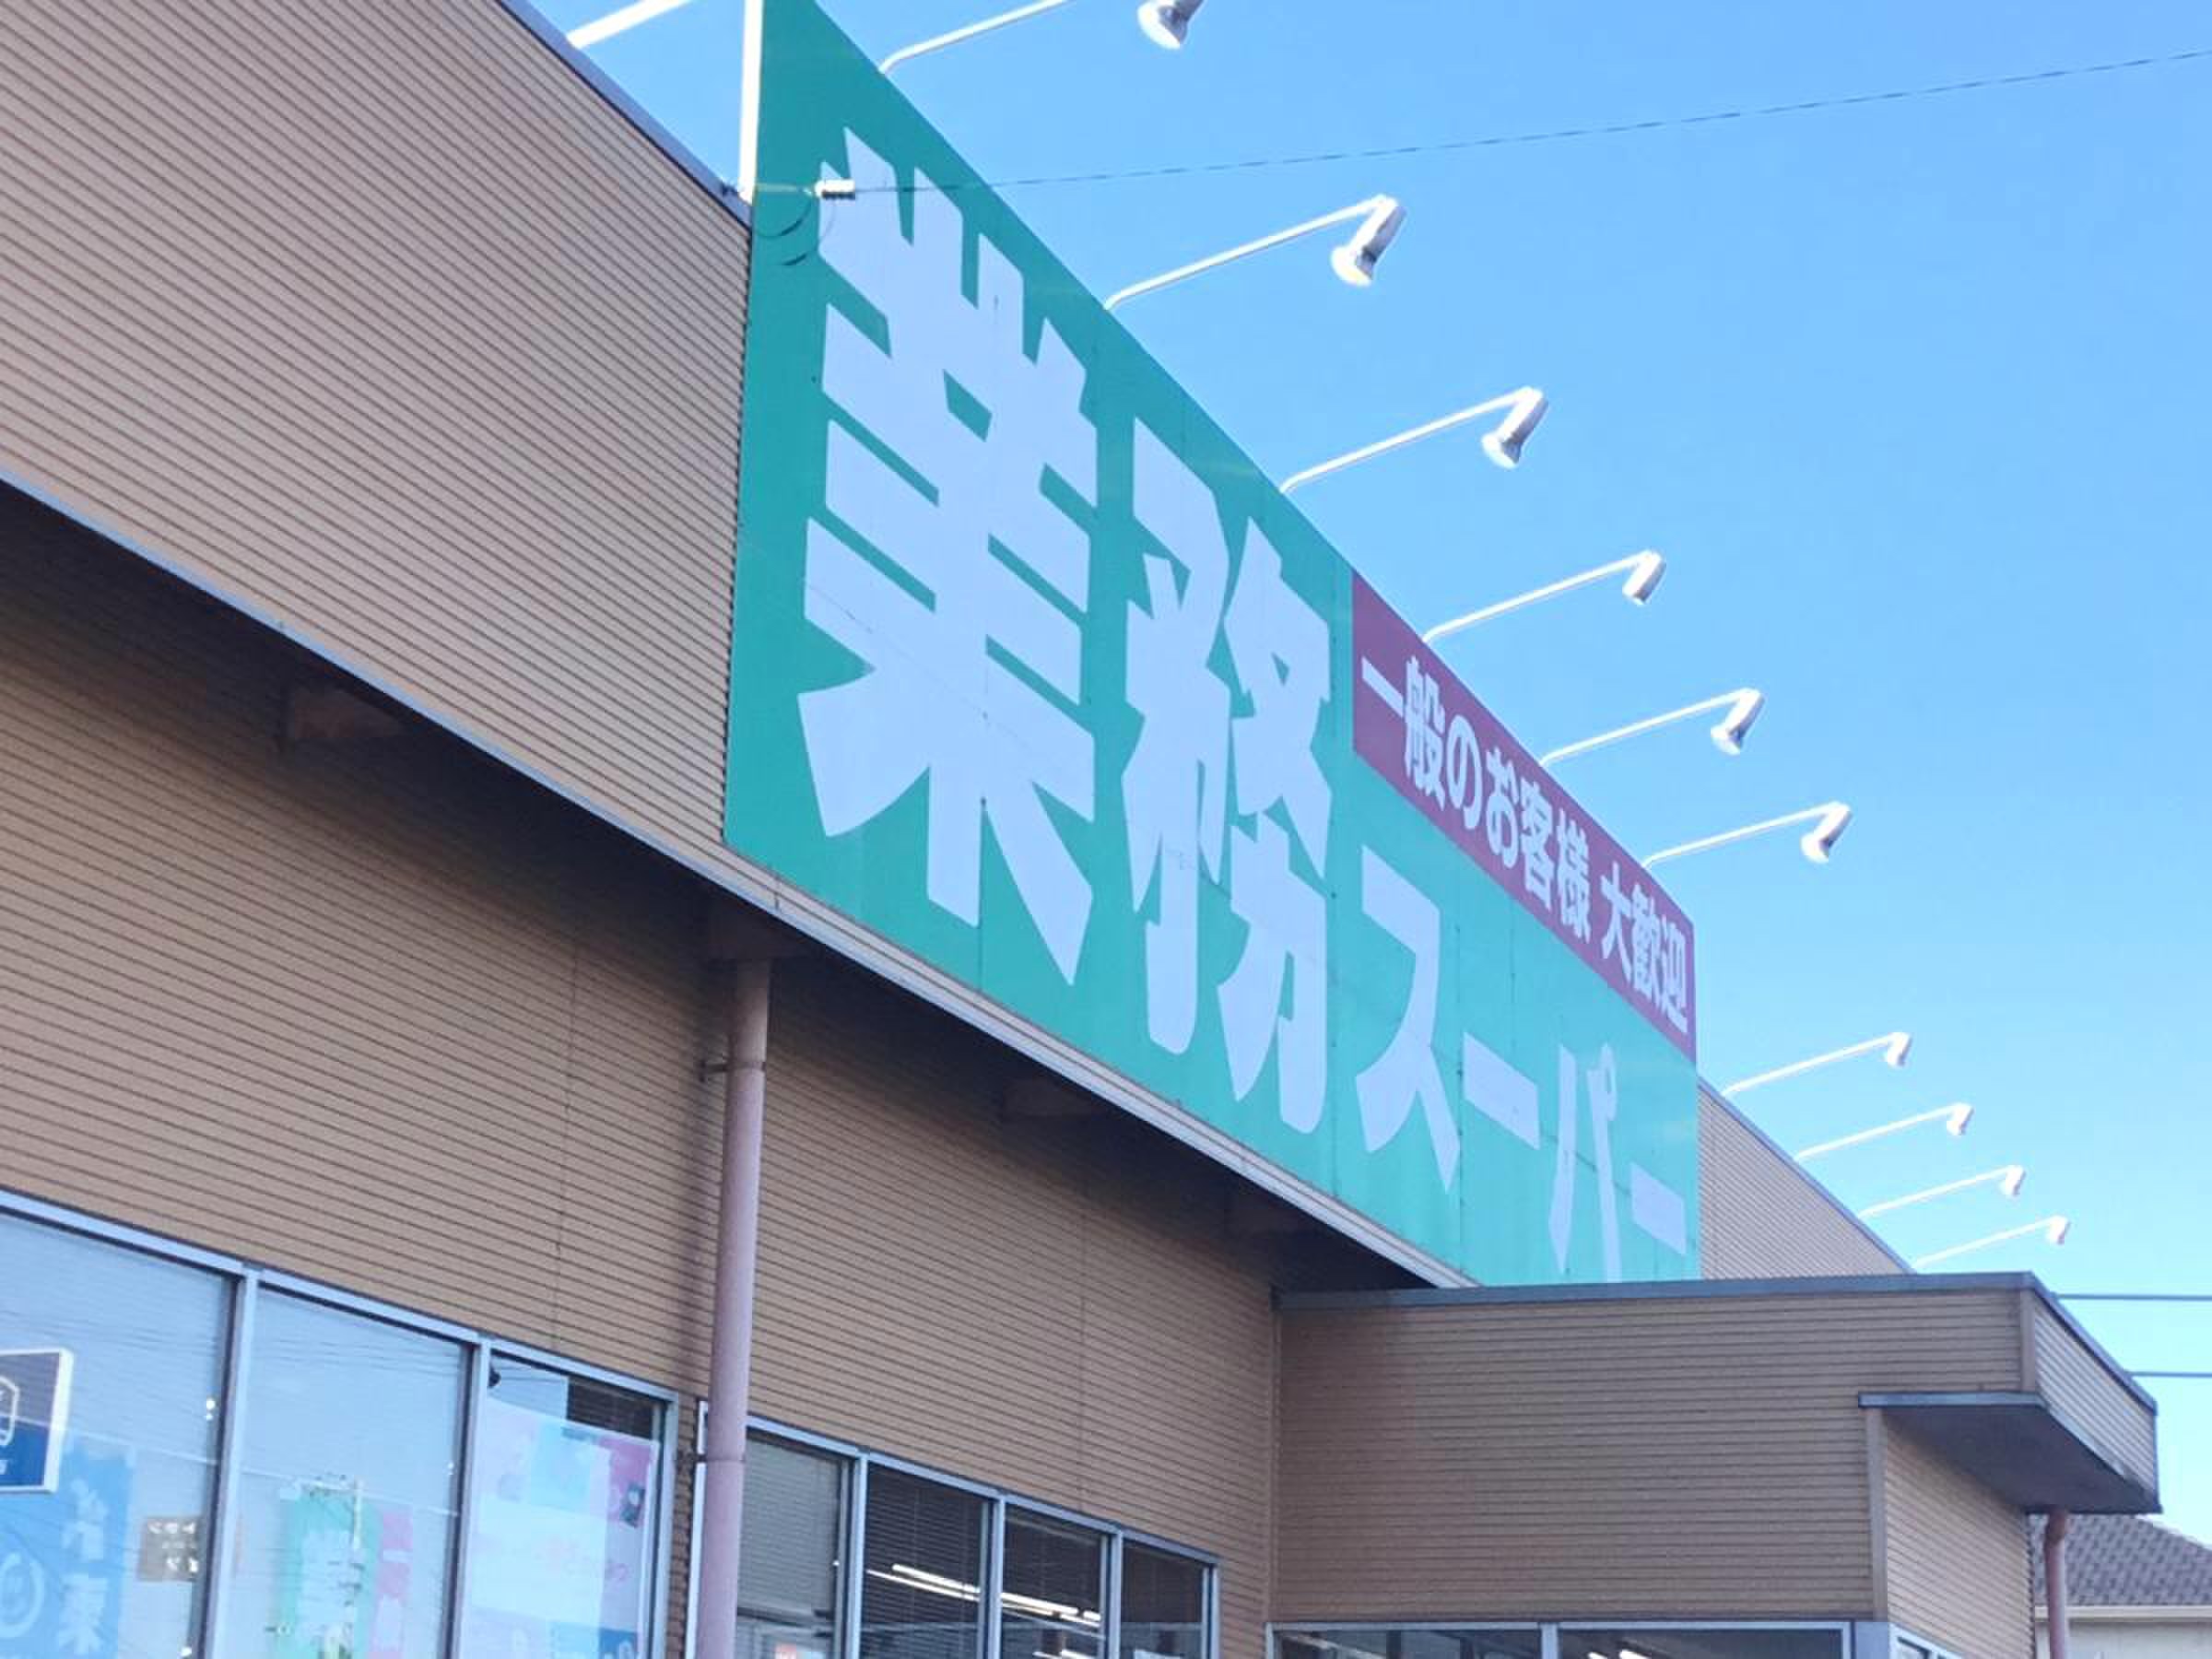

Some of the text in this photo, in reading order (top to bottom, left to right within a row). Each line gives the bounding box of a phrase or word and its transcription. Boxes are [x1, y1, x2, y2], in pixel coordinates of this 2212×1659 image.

[799, 128, 1687, 1283] 業務スーパー
[1361, 655, 1688, 1033] 一般のお客様 大歓迎
